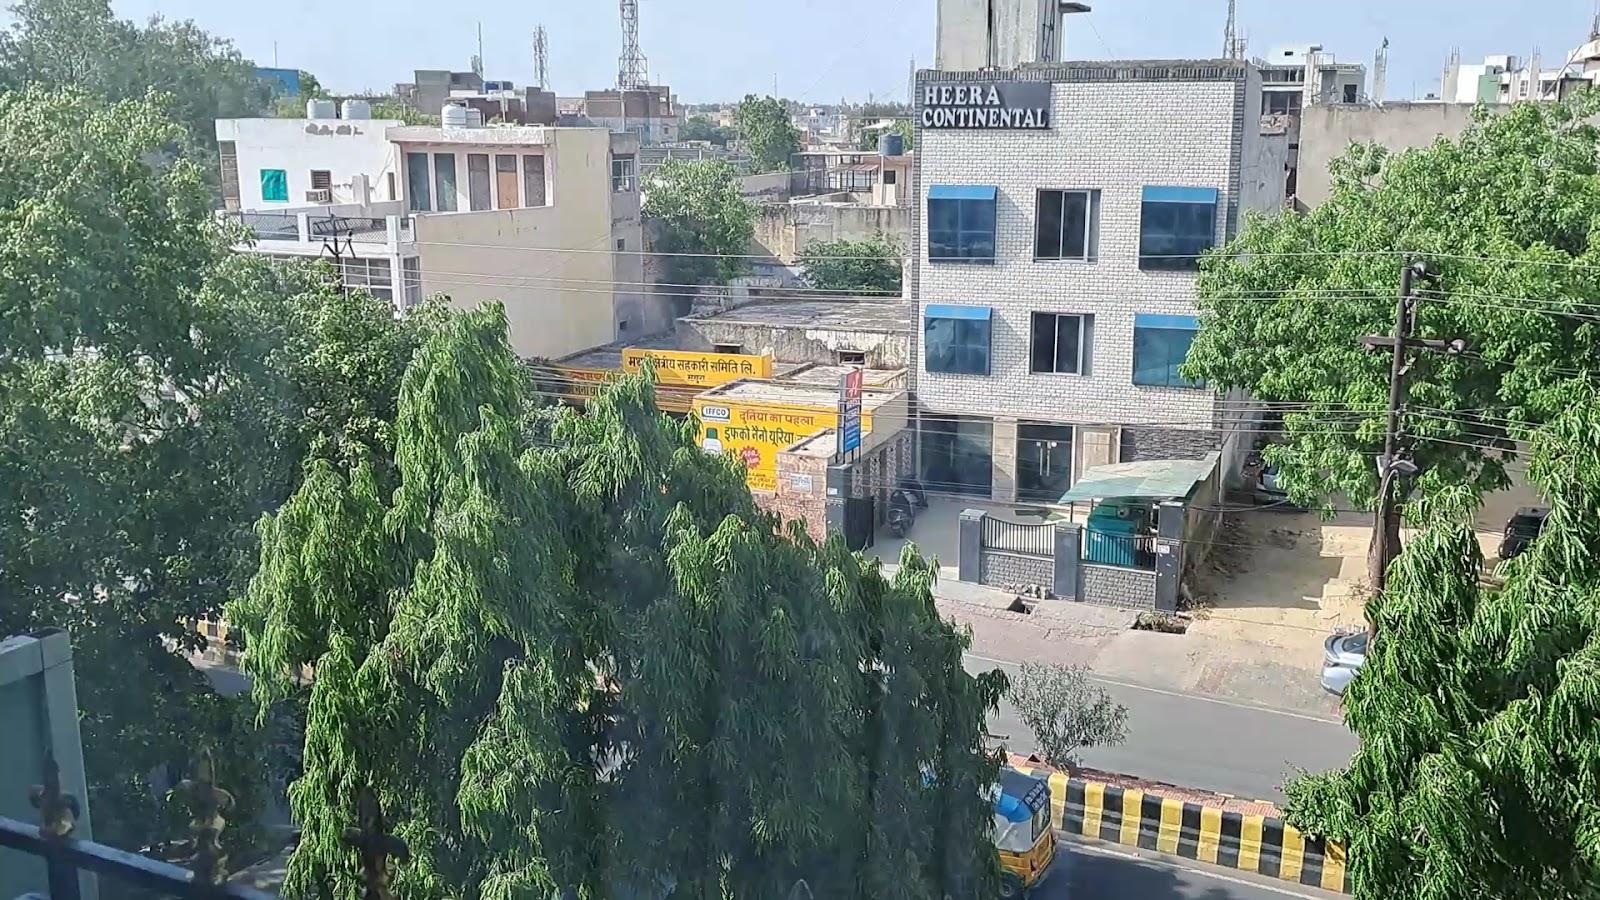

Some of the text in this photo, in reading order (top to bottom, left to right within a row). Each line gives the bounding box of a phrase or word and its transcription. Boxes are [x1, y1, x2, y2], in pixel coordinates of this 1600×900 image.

[924, 85, 1001, 106] HEERA
[922, 108, 1047, 128] CONTINENTAL
[677, 357, 709, 372] सहकारी
[710, 358, 738, 374] समिति
[705, 407, 727, 417] IFFCO
[739, 409, 768, 424] दुनिया
[769, 413, 783, 423] का
[784, 415, 814, 427] पहला
[724, 425, 750, 442] इफको
[751, 425, 768, 442] नैनो
[769, 427, 795, 447] यूरिया
